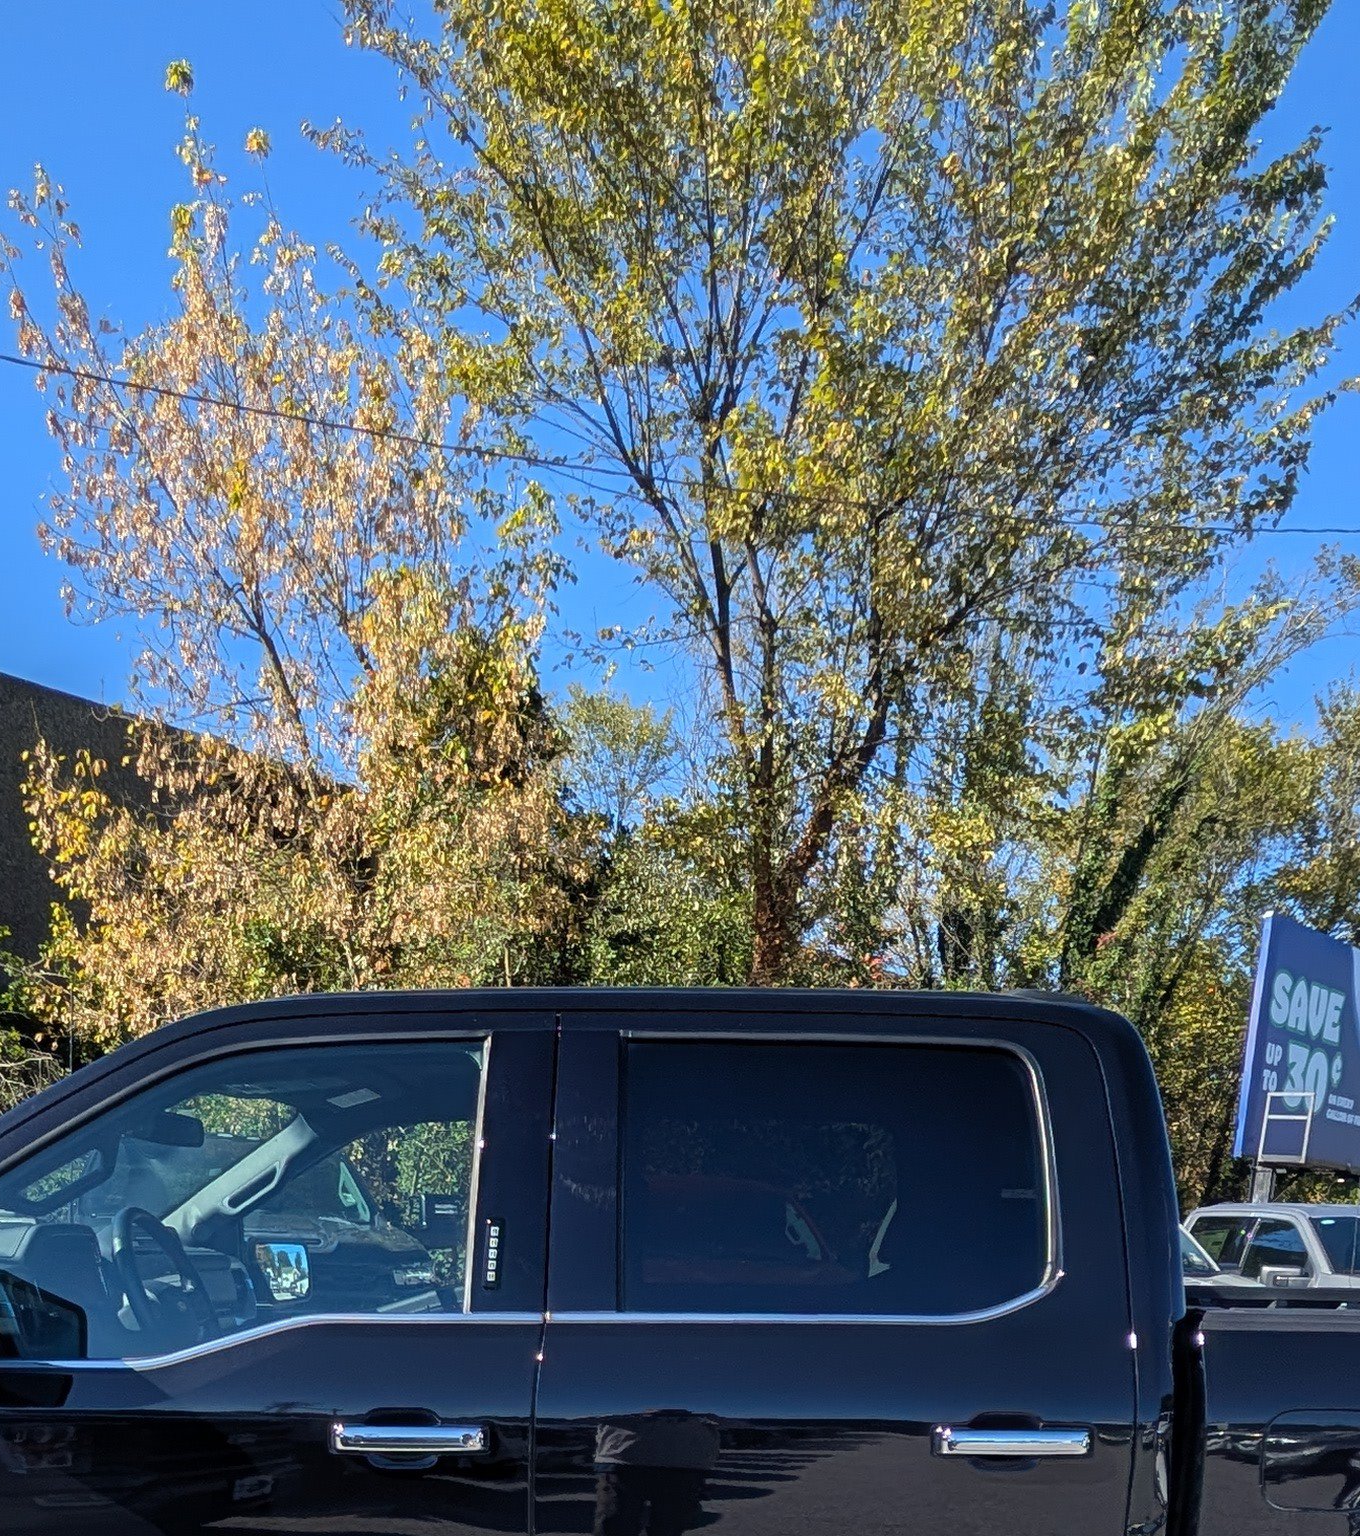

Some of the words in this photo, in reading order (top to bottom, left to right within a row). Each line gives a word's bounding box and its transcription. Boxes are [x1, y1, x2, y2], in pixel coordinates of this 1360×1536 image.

[1270, 972, 1345, 1044] SAVE
[1265, 1042, 1283, 1067] UP
[1262, 1069, 1278, 1092] TO
